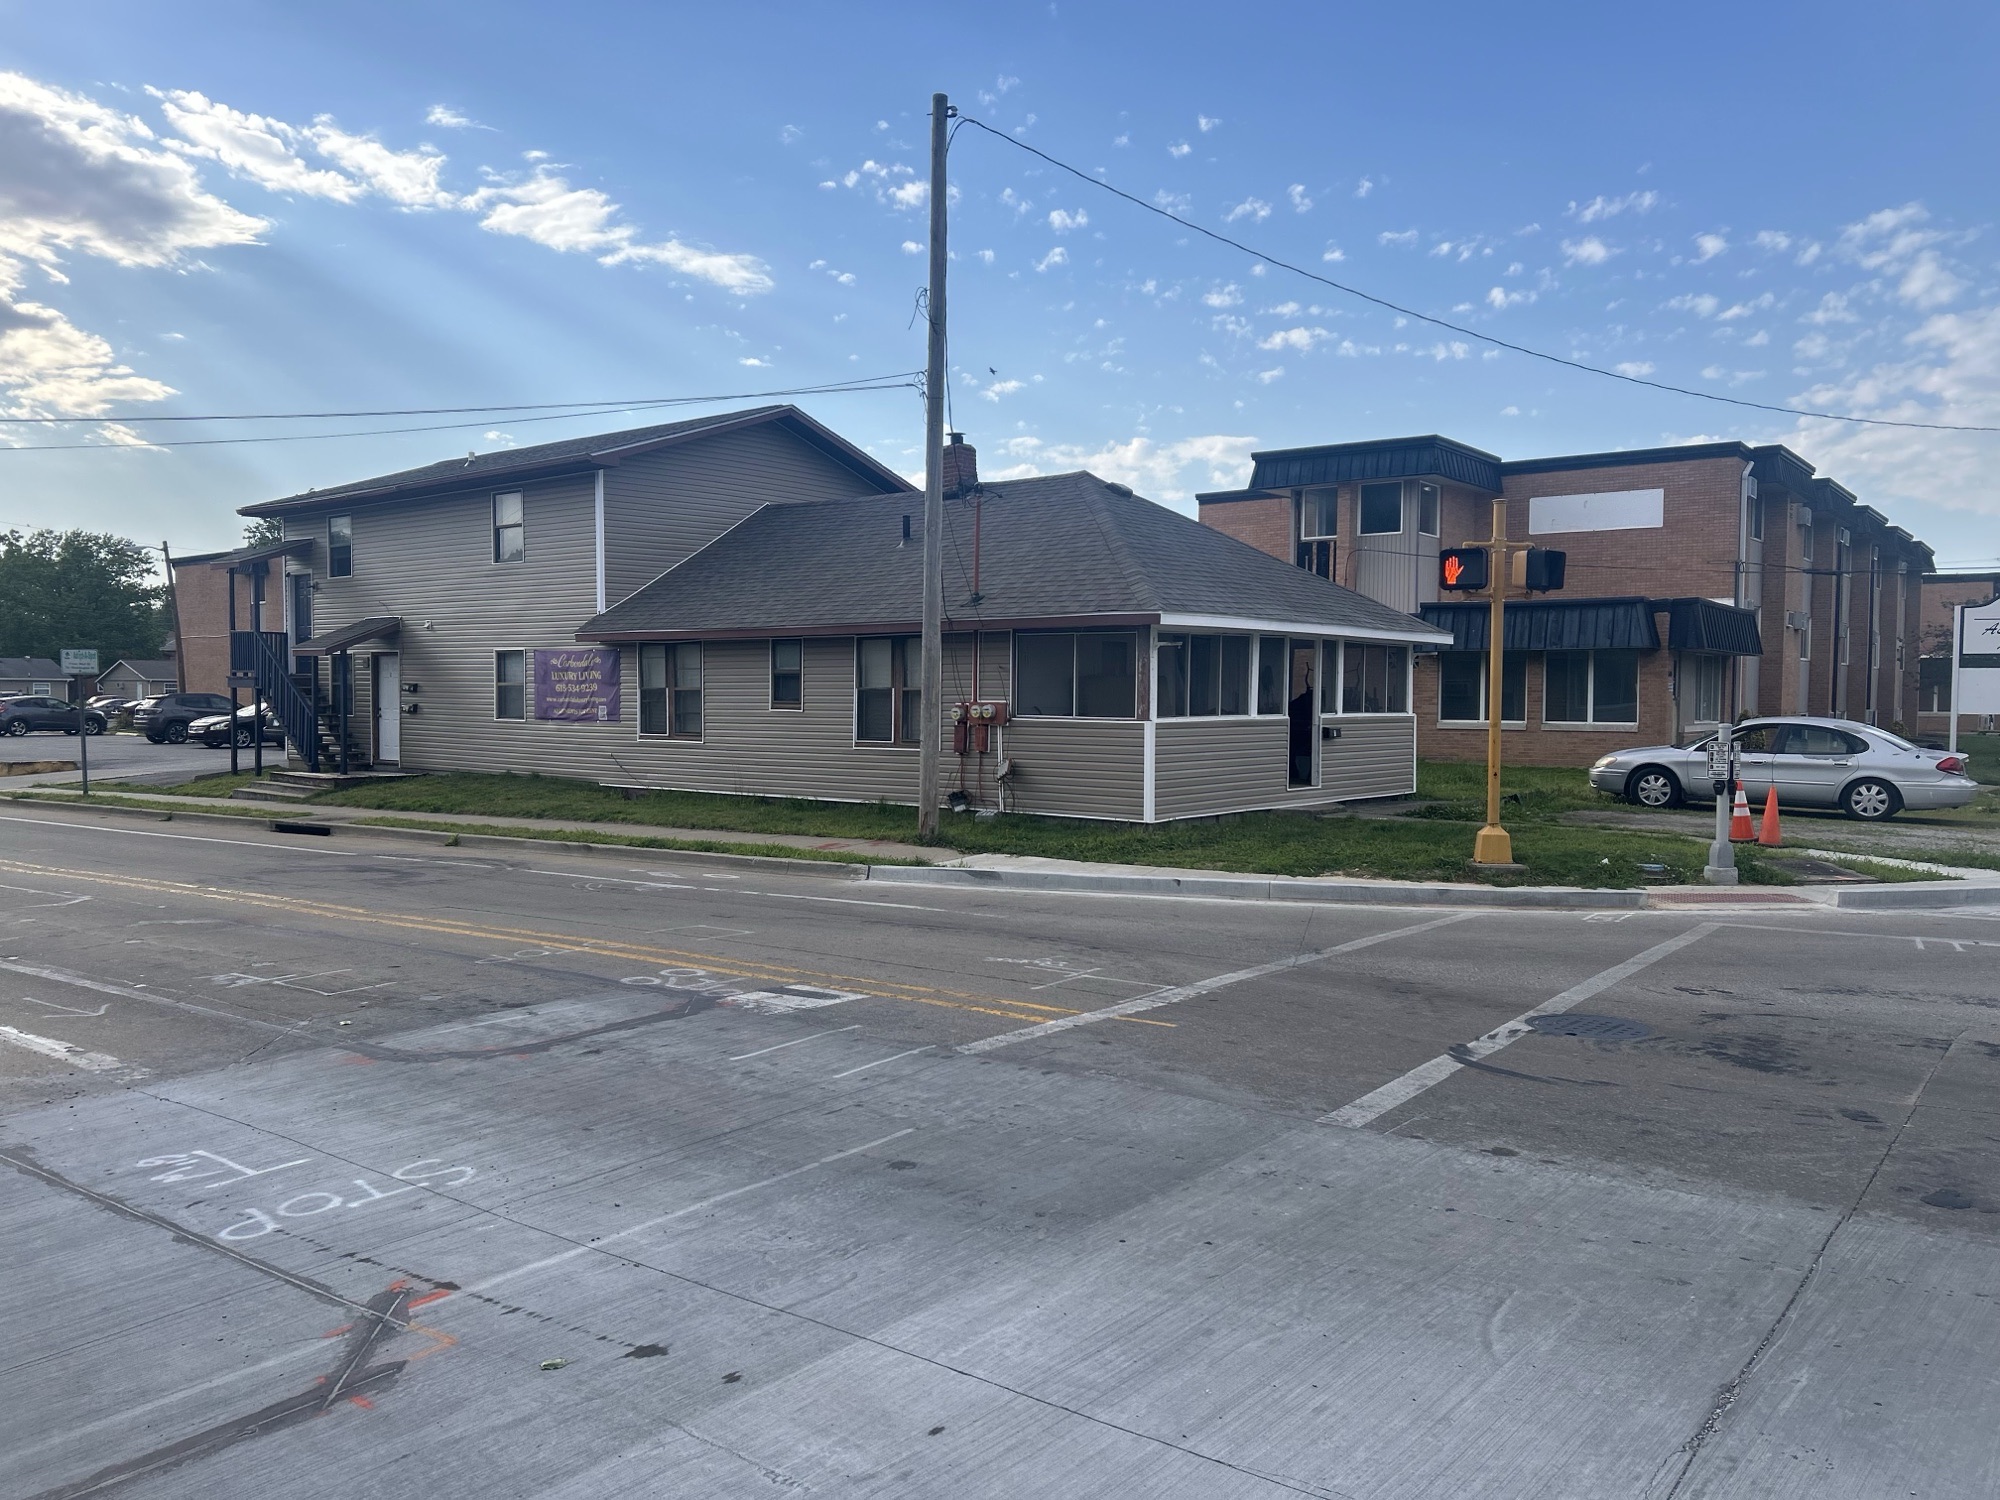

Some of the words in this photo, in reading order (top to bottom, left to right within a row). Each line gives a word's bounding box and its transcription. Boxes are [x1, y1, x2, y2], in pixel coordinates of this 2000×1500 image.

[551, 671, 578, 681] LUXURY
[578, 671, 602, 680] LIVING
[217, 1158, 478, 1242] STOP
